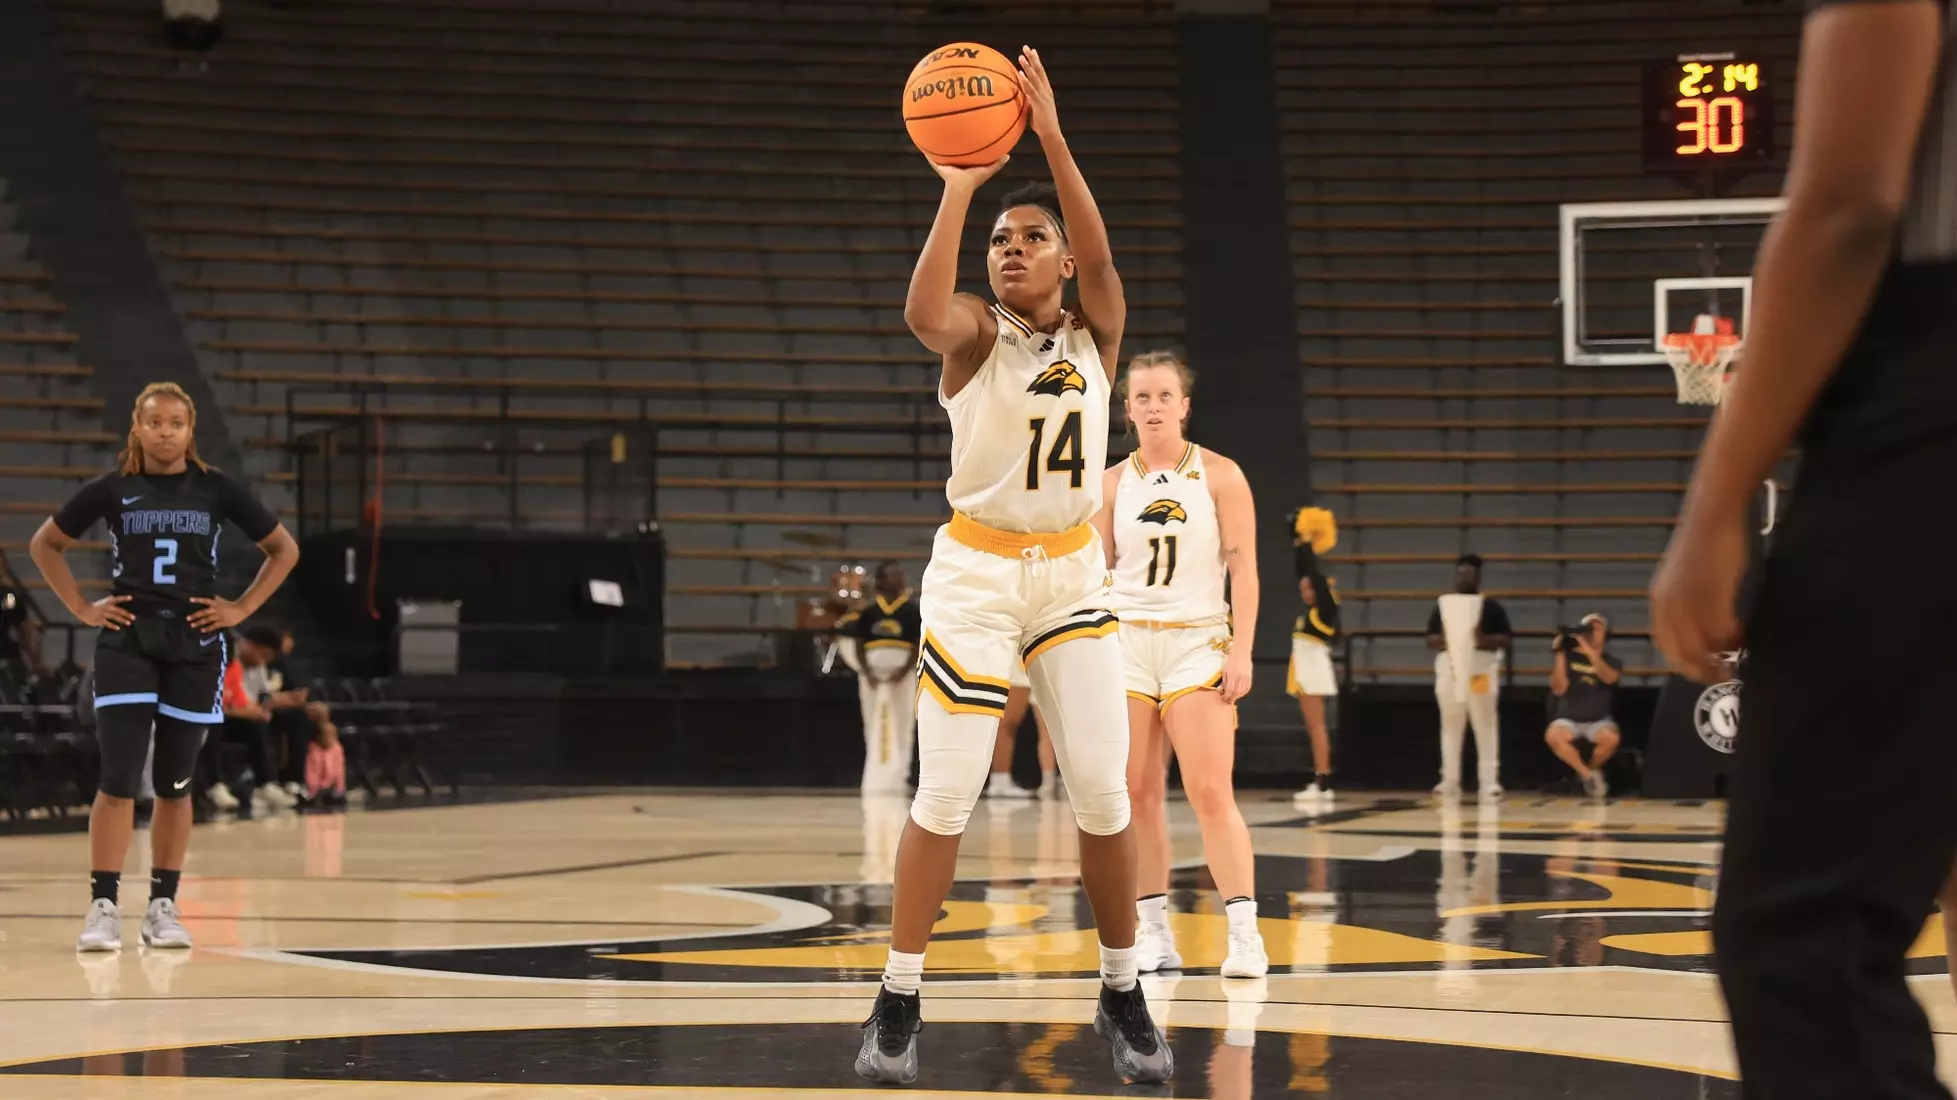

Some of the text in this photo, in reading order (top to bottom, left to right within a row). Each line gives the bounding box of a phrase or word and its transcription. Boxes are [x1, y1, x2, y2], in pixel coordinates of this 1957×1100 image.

[912, 76, 995, 102] Wilson
[1680, 62, 1758, 97] 2:14
[1676, 97, 1744, 154] 30
[1025, 410, 1085, 491] 14
[121, 510, 211, 536] TOPPERS
[153, 539, 178, 585] 2
[1146, 535, 1177, 587] 11
